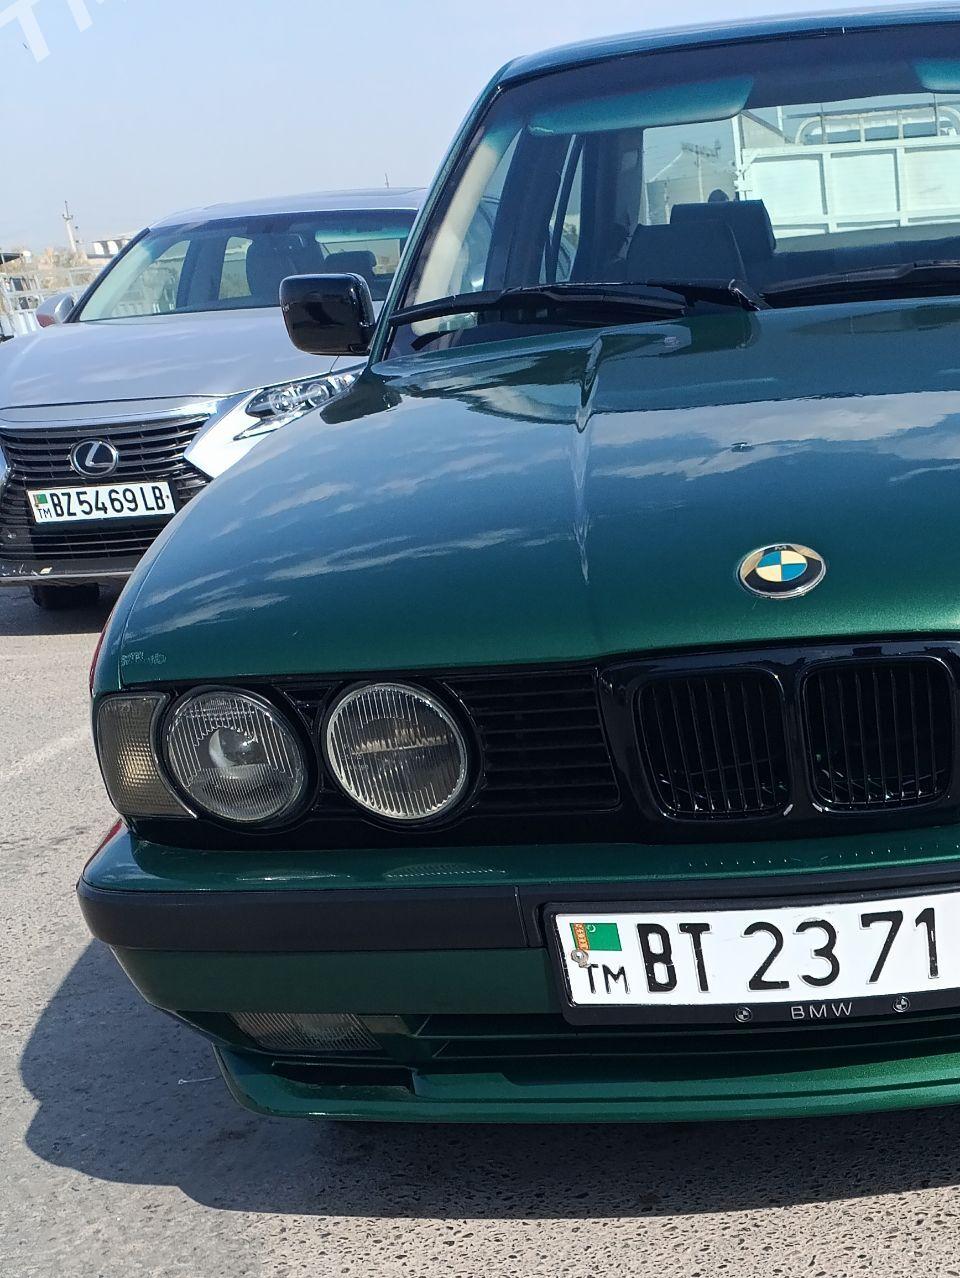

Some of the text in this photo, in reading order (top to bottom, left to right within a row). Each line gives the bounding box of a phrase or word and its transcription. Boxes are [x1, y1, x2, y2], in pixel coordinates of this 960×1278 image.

[37, 507, 53, 519] TM
[585, 961, 631, 995] TM
[790, 1001, 853, 1020] BMW
